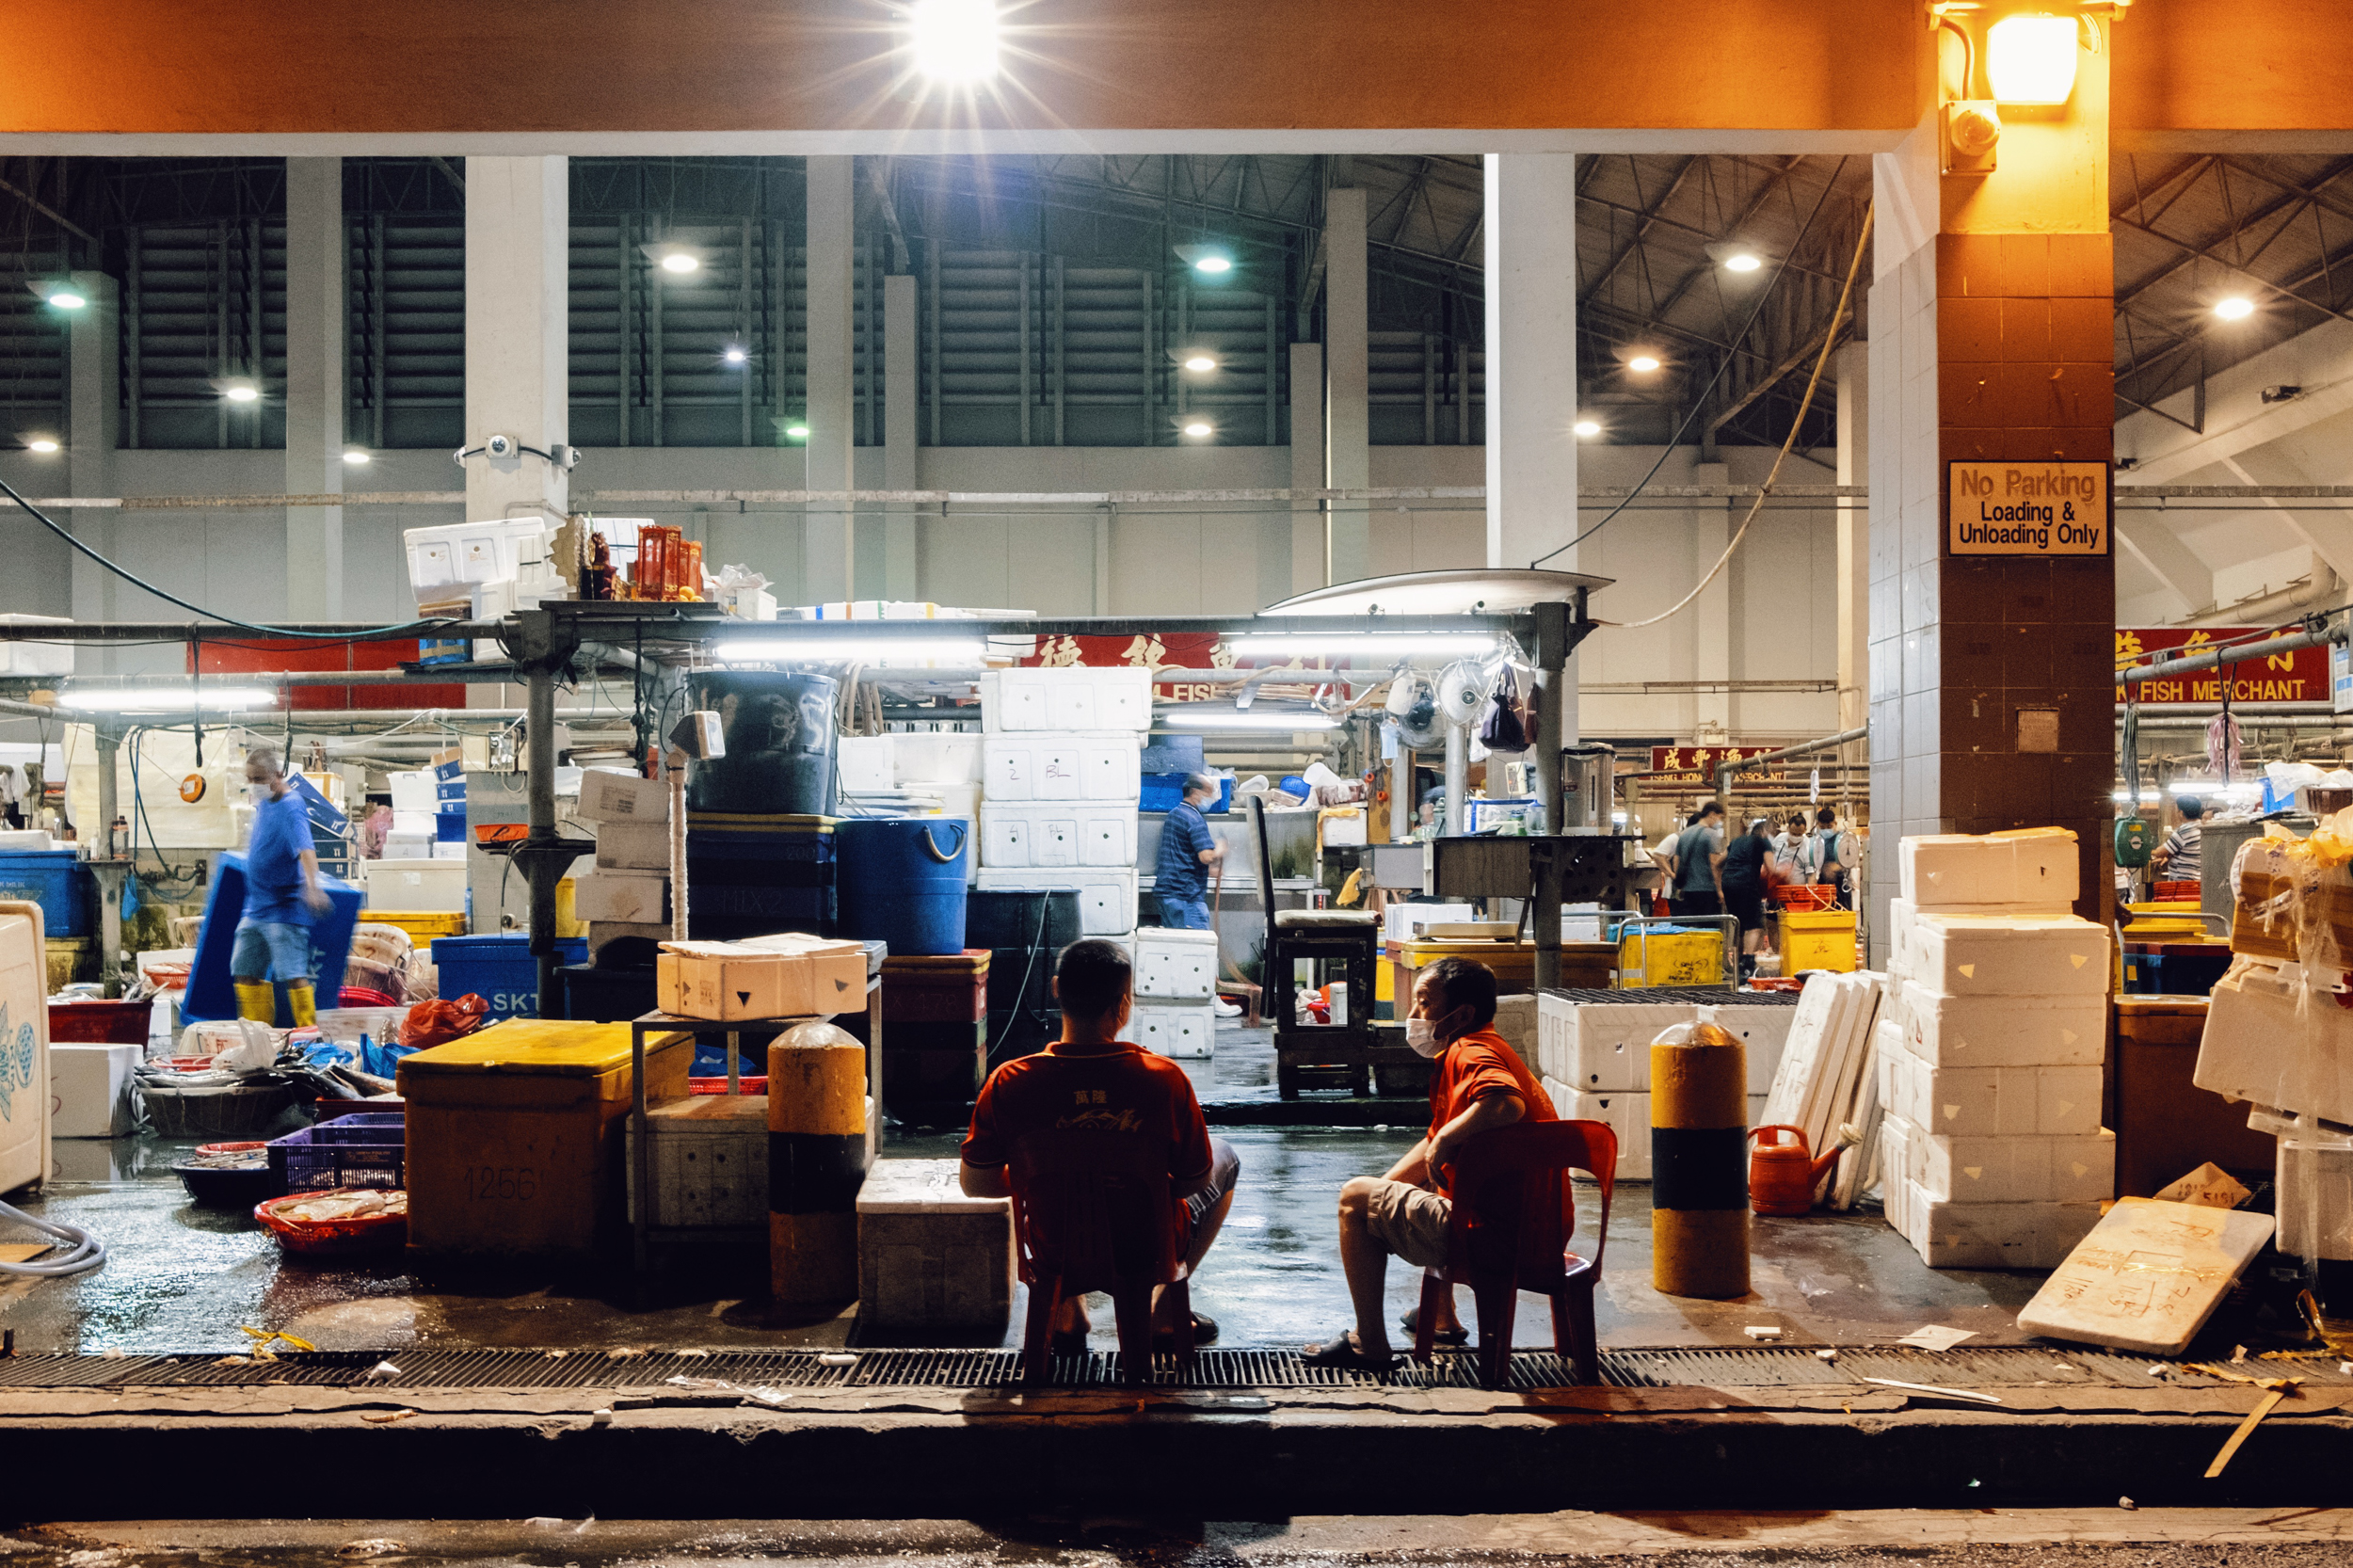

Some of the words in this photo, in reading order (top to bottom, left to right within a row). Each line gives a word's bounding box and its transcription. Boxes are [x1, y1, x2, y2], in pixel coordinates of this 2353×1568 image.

[1961, 469, 1994, 497] No
[2006, 469, 2095, 504] Parking
[1981, 501, 2053, 526] Loading
[2062, 501, 2075, 521] &
[1960, 523, 2048, 549] Unloading
[2057, 523, 2099, 550] Only
[2140, 681, 2184, 701] FISH
[2192, 680, 2305, 700] MERCHANT
[493, 993, 539, 1012] SKT
[464, 1167, 536, 1202] 1256
